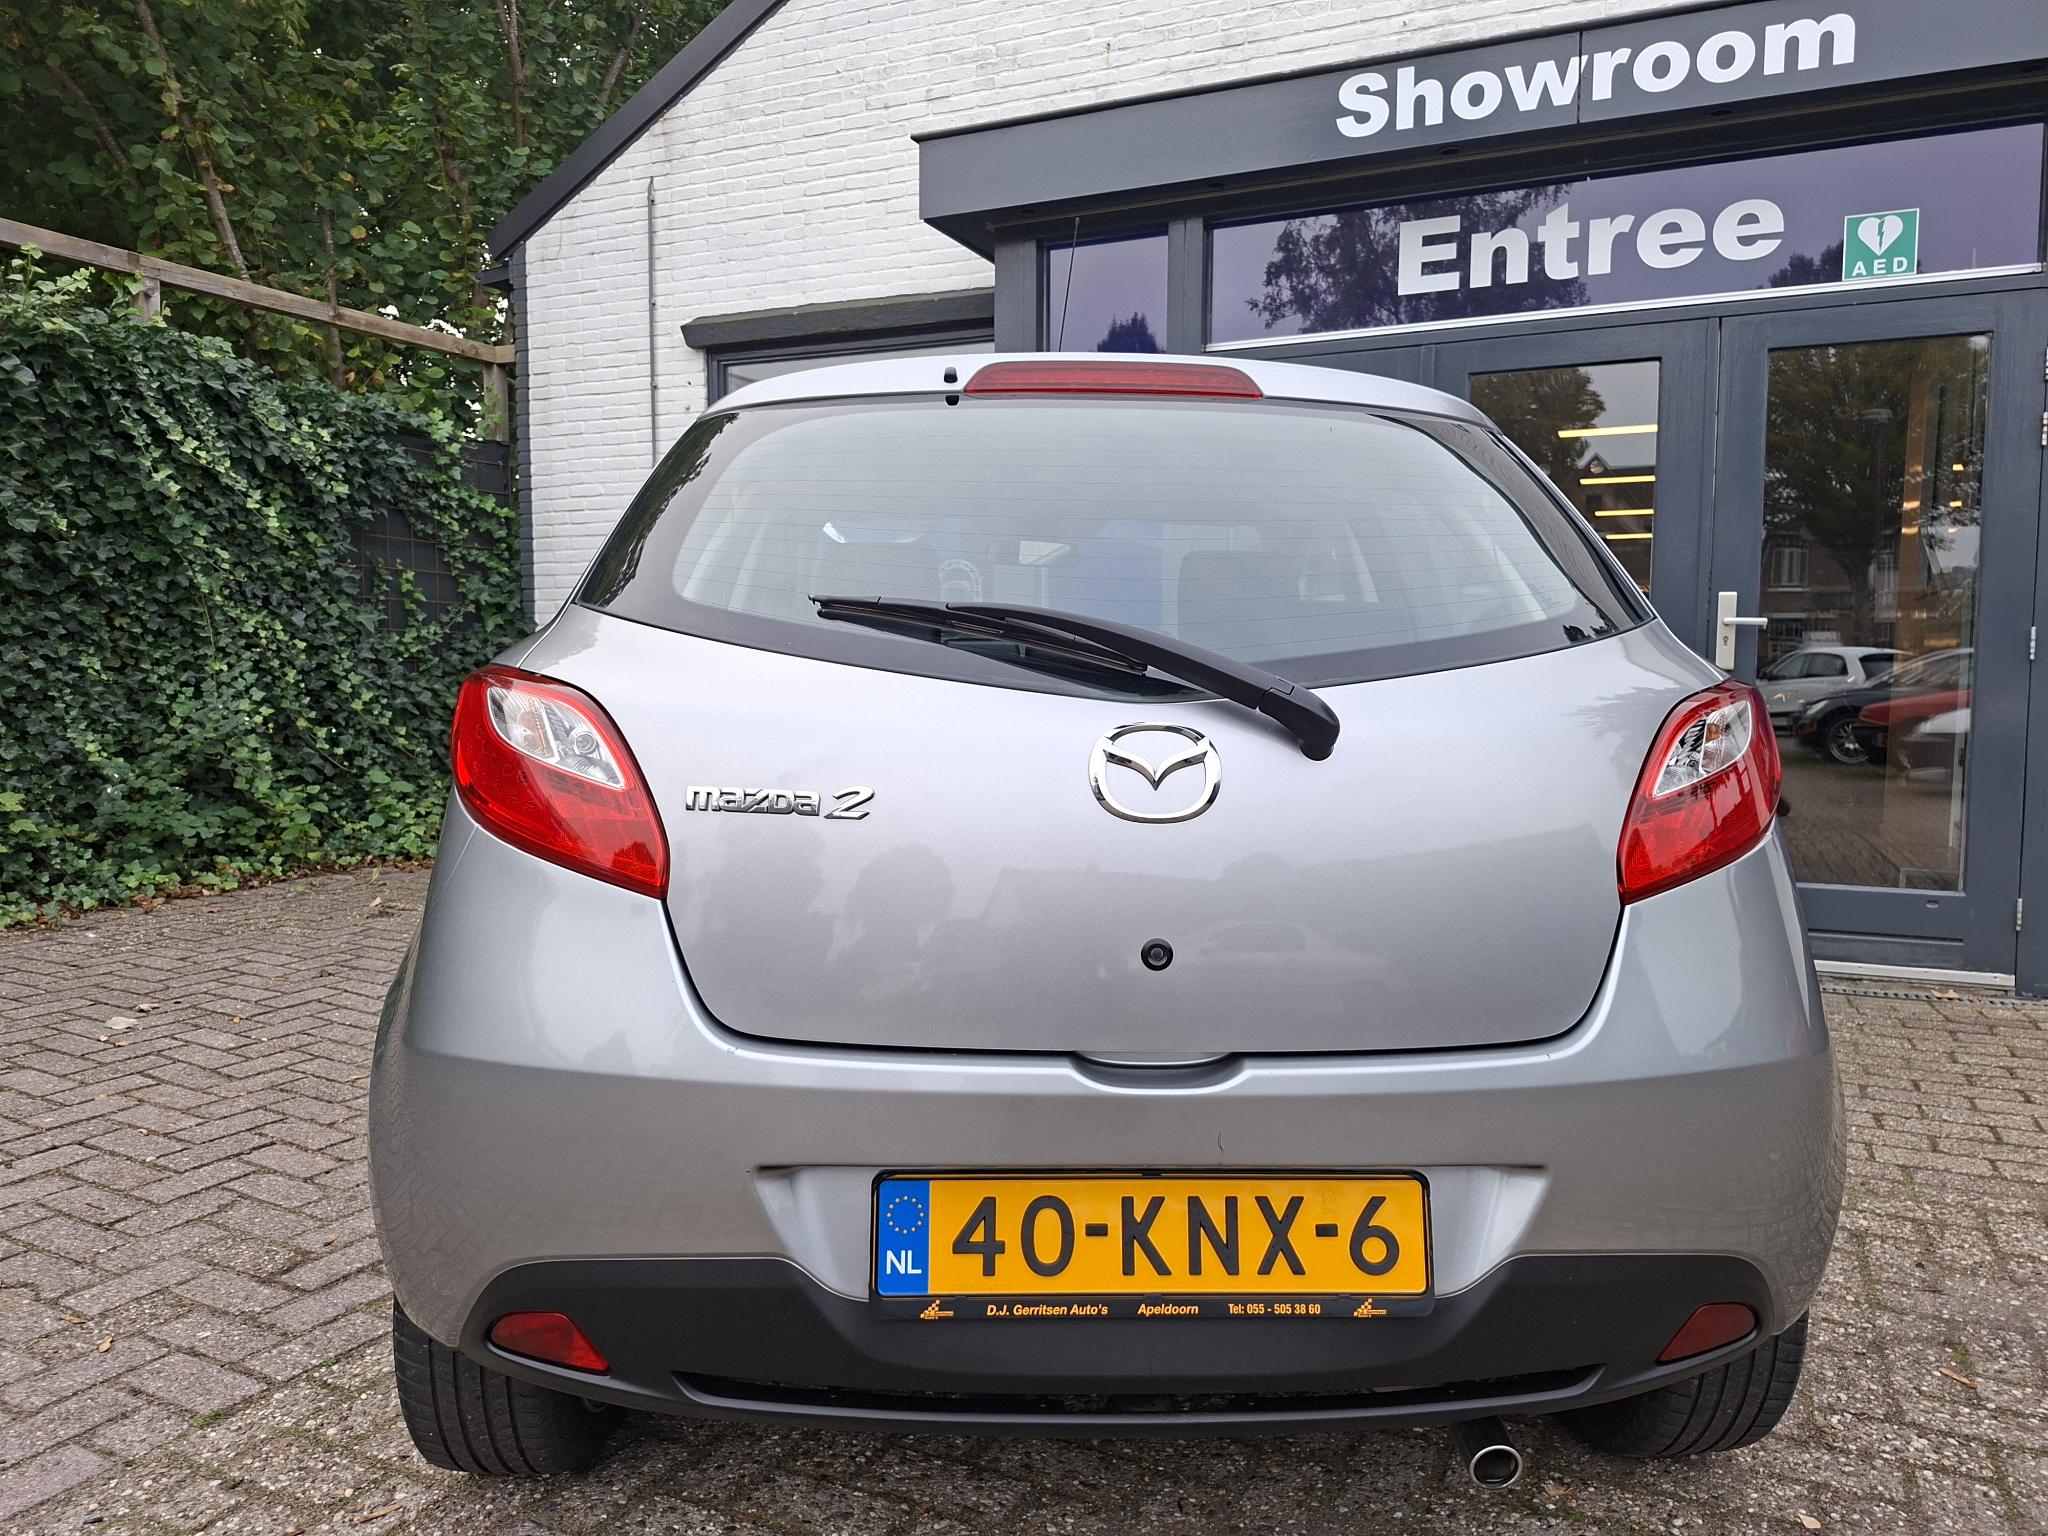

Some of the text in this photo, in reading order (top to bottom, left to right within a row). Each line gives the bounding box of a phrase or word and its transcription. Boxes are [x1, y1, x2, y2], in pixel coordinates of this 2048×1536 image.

[1336, 13, 1856, 138] Showroom
[1397, 198, 1785, 296] Entree
[1852, 257, 1909, 278] AED
[823, 785, 876, 820] 2
[952, 1195, 1400, 1277] 40-KNX-6
[886, 1249, 922, 1275] NL
[986, 1304, 1010, 1316] D.J.
[1013, 1304, 1068, 1316] Gerritsen
[1070, 1303, 1109, 1315] Auto's
[1137, 1303, 1199, 1317] Apeldoorn
[1228, 1303, 1245, 1314] Tel:
[1246, 1303, 1265, 1314] 055
[1274, 1303, 1292, 1314] 505
[1294, 1303, 1307, 1314] 38
[1308, 1303, 1321, 1314] 60
